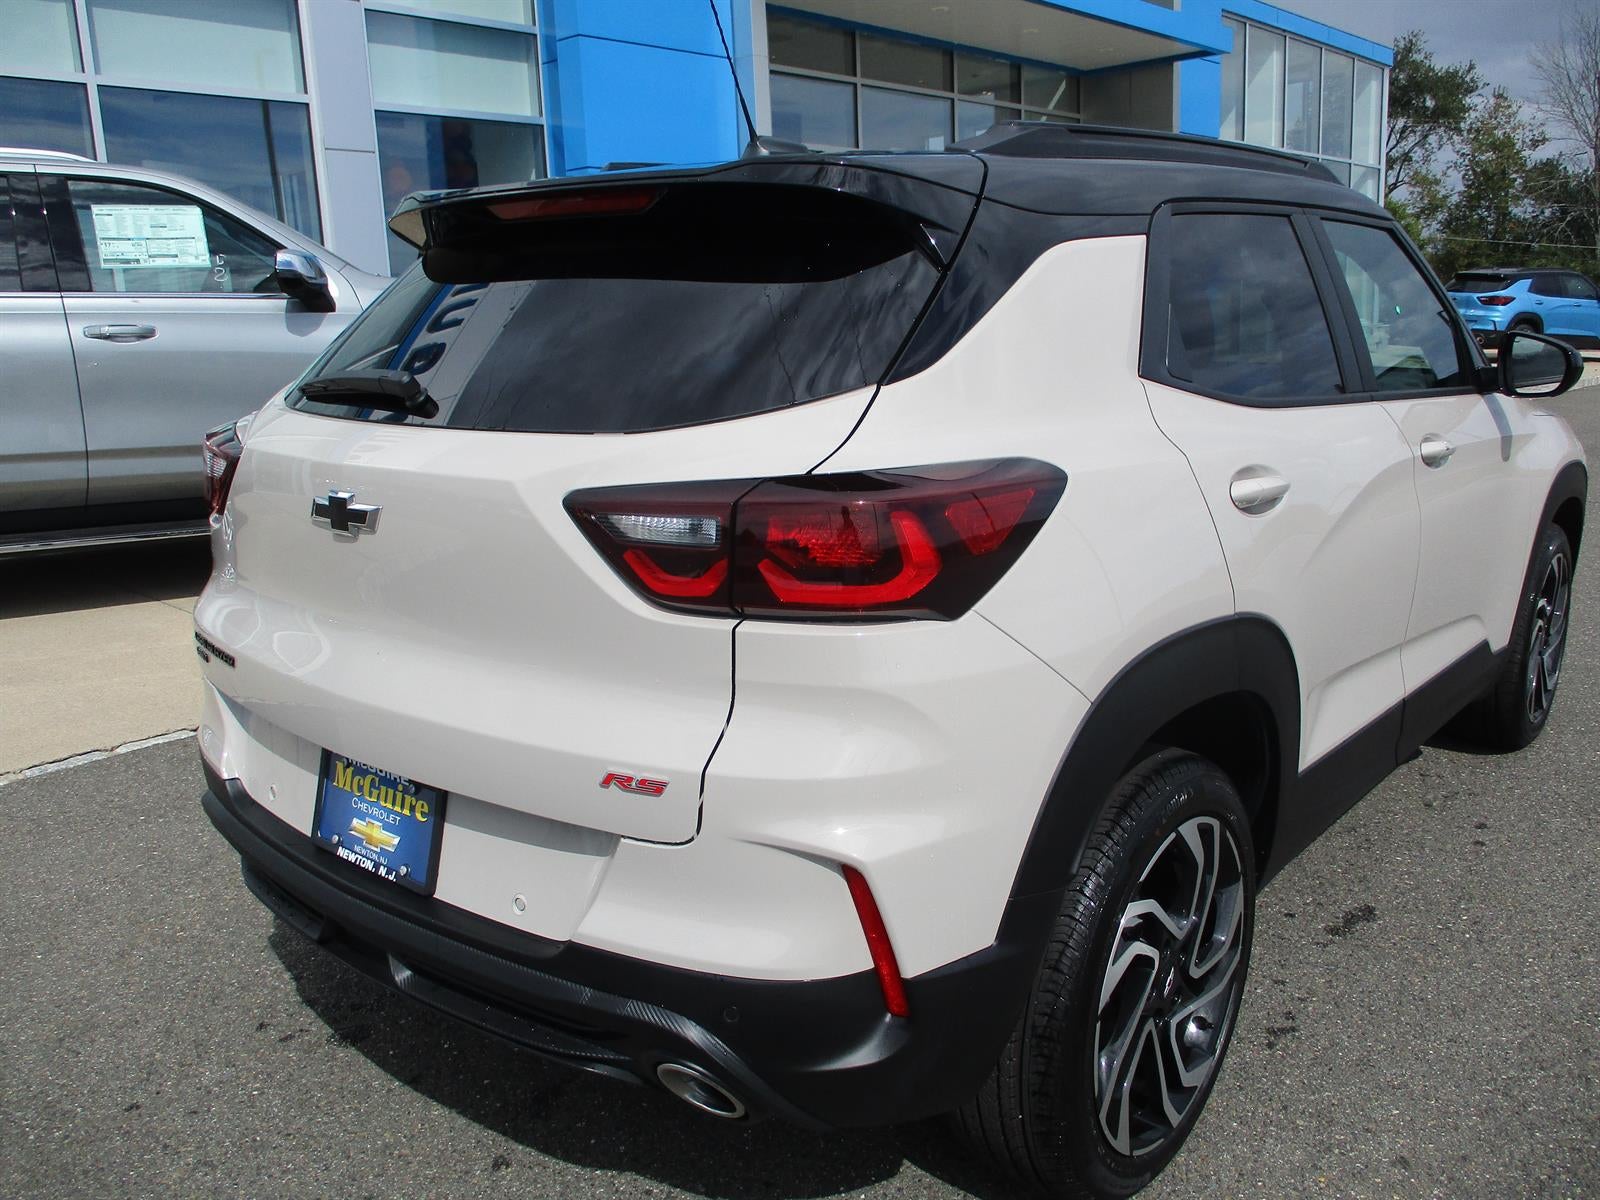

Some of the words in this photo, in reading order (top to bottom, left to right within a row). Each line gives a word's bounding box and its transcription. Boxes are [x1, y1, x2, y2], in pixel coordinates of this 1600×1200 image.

[333, 760, 429, 822] McGuire
[599, 771, 670, 798] RS
[351, 797, 401, 826] CHEVROLET
[337, 847, 375, 872] NEWTON,
[377, 865, 397, 882] N.J.
